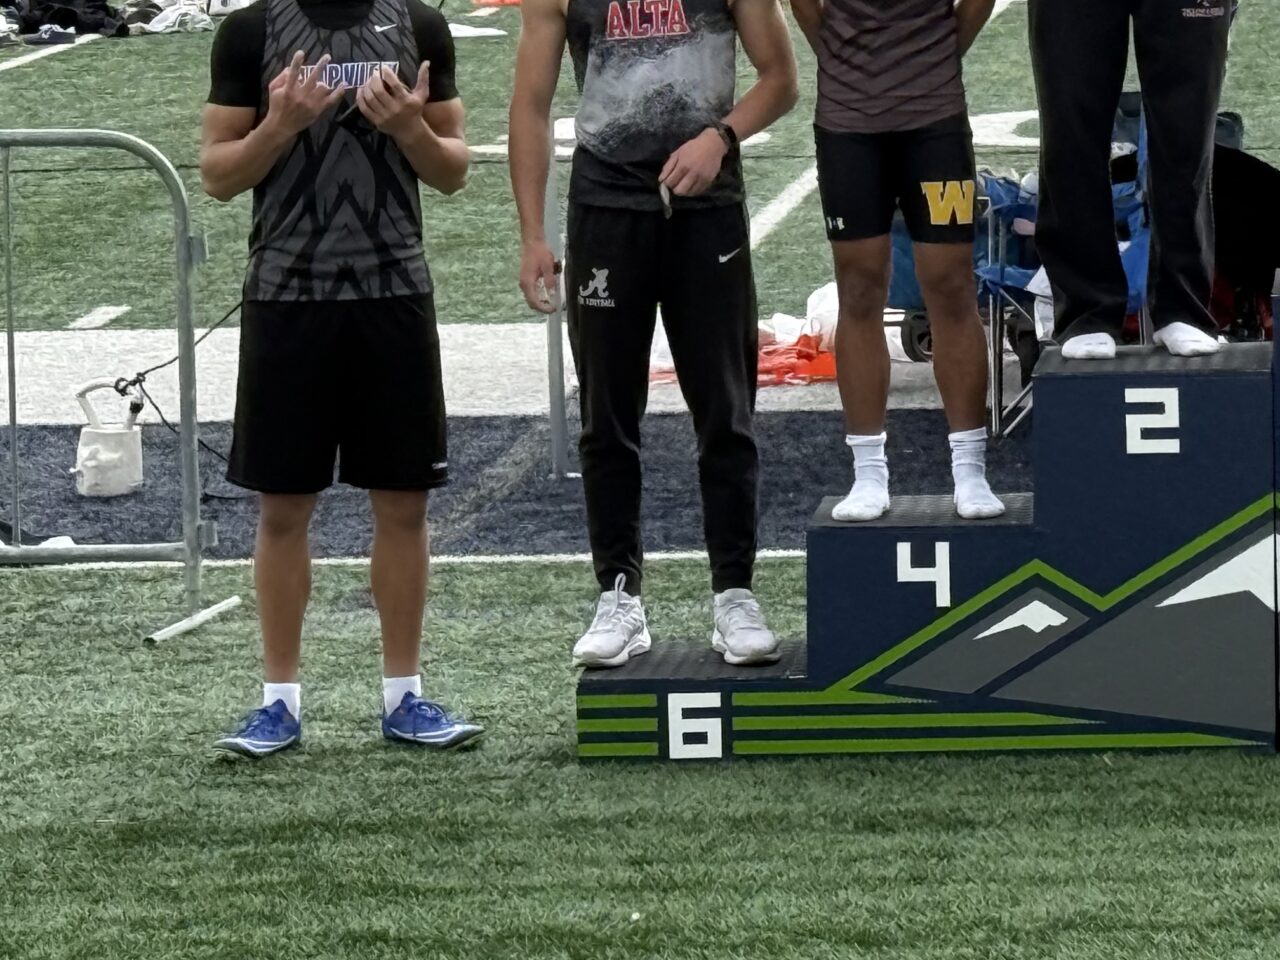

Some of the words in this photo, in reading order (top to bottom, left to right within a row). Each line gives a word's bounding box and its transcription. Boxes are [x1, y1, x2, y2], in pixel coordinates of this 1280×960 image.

[920, 180, 975, 225] W
[1124, 387, 1180, 454] 2
[896, 541, 951, 607] 4
[667, 692, 722, 759] 6
